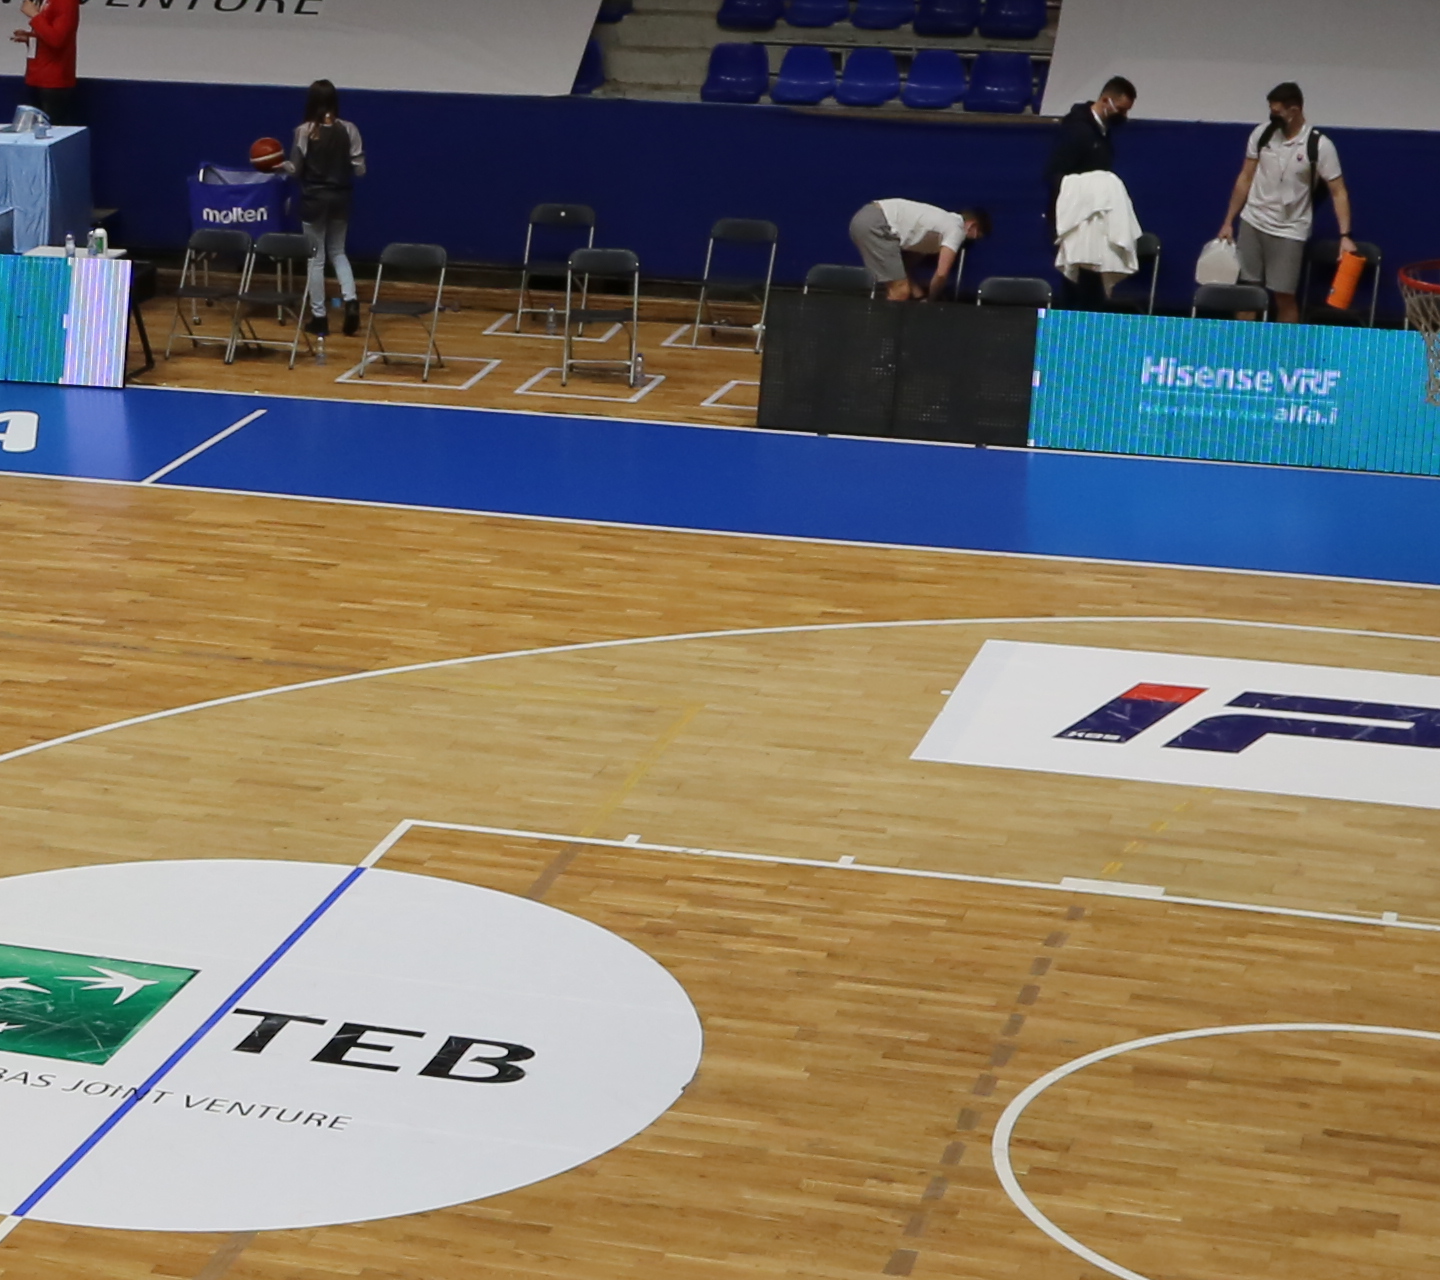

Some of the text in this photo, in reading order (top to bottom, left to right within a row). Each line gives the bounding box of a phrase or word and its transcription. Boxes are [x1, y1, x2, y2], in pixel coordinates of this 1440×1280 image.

[202, 206, 269, 225] molten
[1140, 355, 1342, 396] Hisense VRF
[231, 1007, 536, 1084] TEB
[182, 1094, 354, 1133] VENTURE
